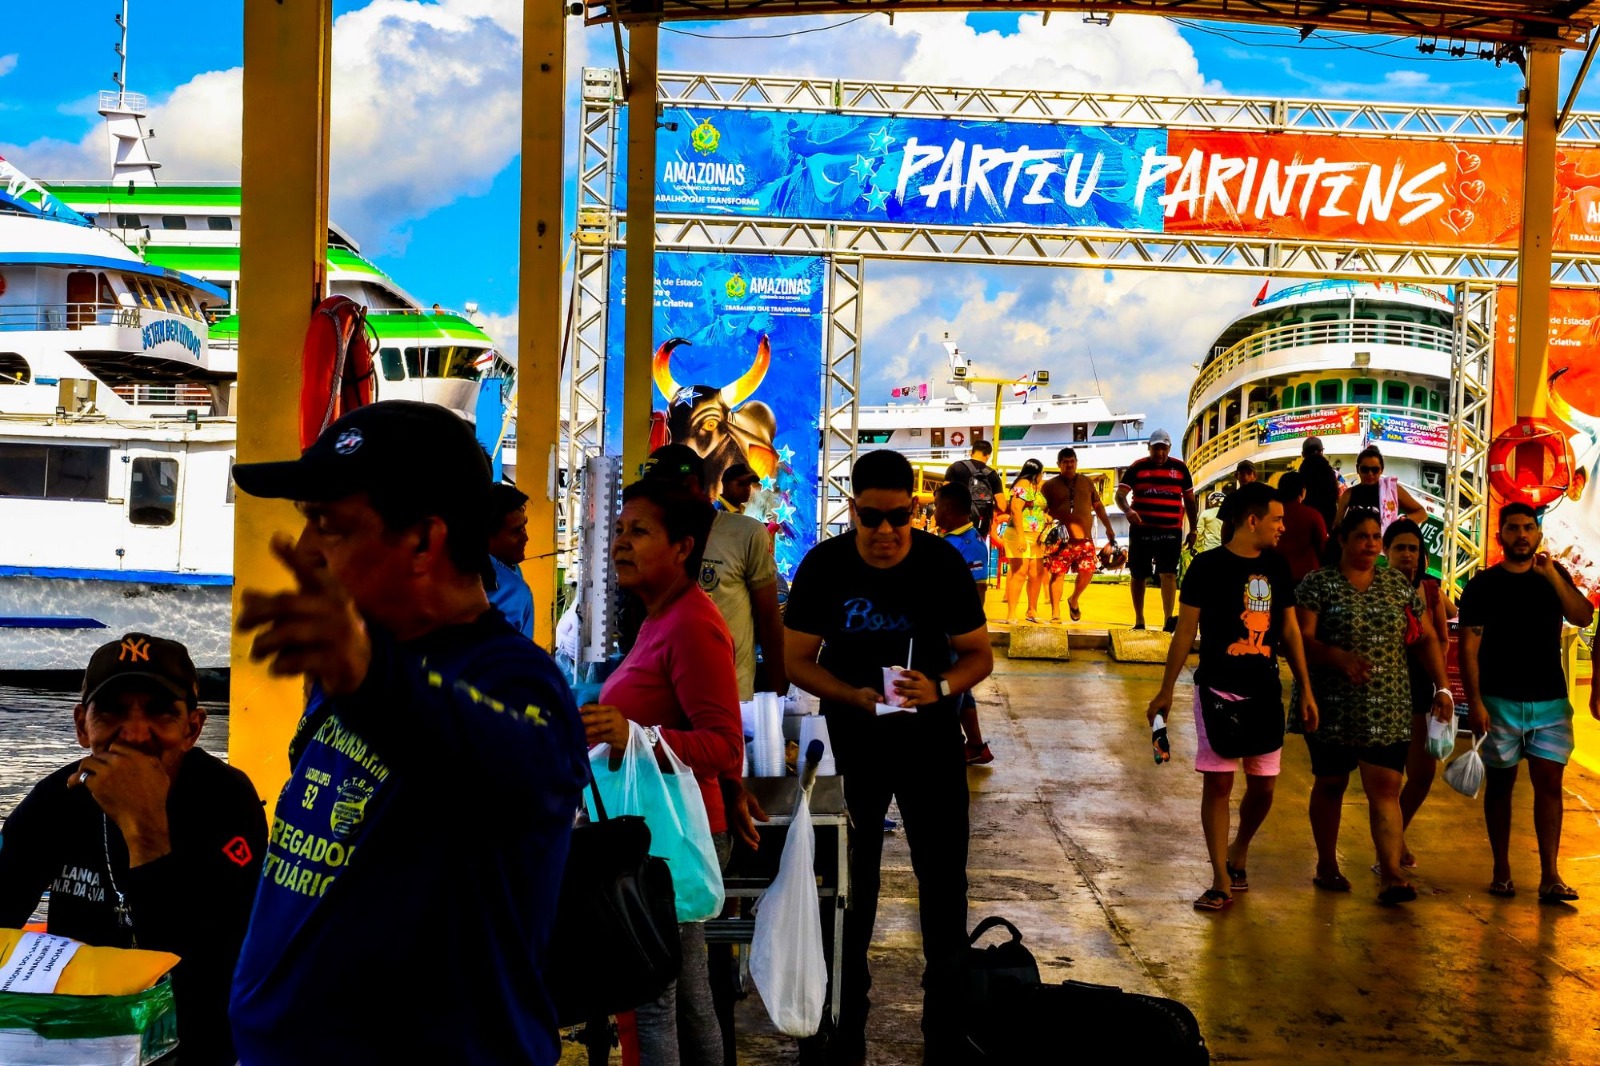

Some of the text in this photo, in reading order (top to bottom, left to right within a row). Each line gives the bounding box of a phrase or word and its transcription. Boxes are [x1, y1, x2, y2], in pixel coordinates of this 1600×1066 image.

[663, 161, 746, 186] AMAZONAS
[894, 137, 1447, 231] PARTIU PARINTINS
[655, 194, 760, 206] ABALHO QUE TRANSFORMA
[663, 278, 674, 286] de
[676, 278, 703, 287] Estado
[750, 277, 811, 296] AMAZONAS
[662, 299, 694, 308] Criativa
[1550, 316, 1591, 327] de Estado
[1549, 337, 1582, 347] Criativa
[1410, 422, 1436, 433] SEVERINO
[1386, 433, 1402, 441] PARA
[119, 638, 151, 662] NY
[302, 784, 319, 811] 52
[73, 881, 87, 898] DA
[42, 947, 64, 973] LANCHA
